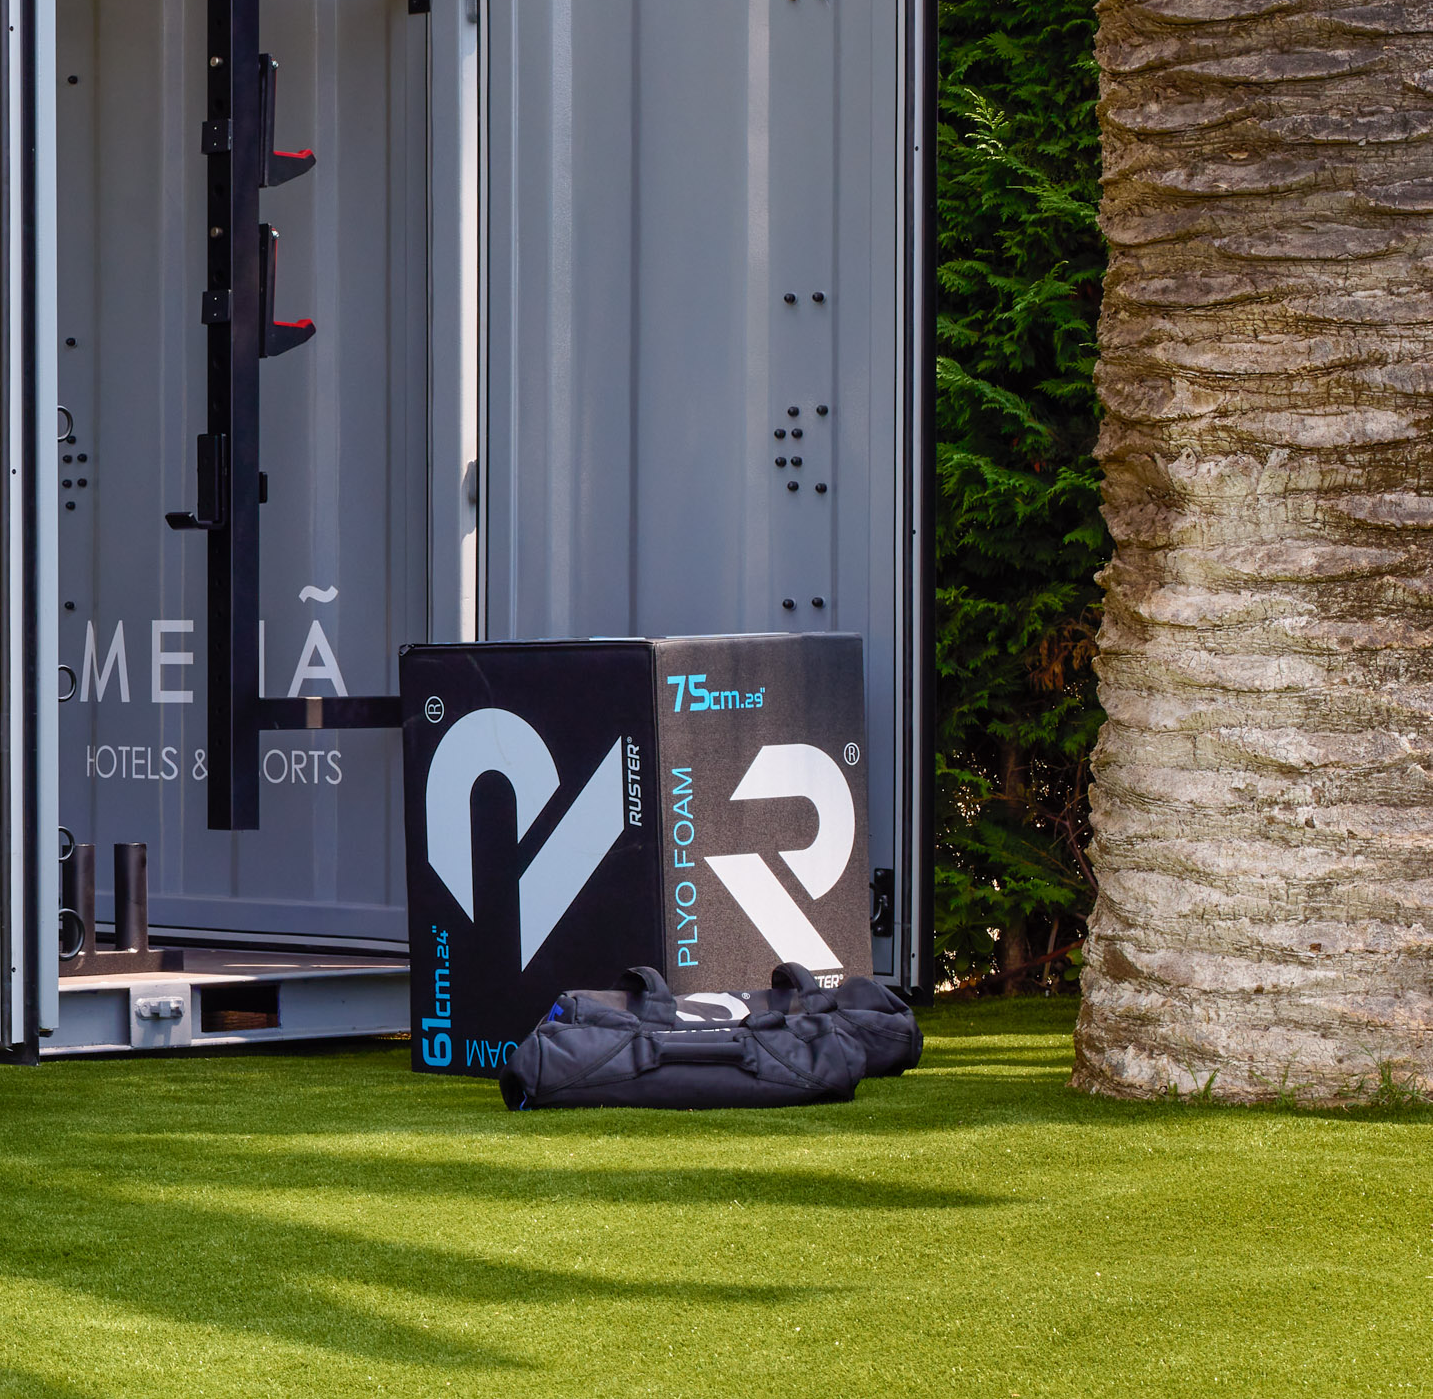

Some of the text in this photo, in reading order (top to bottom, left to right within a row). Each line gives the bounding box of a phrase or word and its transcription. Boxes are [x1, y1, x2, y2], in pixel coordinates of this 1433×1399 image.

[86, 744, 179, 781] HOTELS
[191, 748, 208, 781] &
[671, 767, 699, 968] PLYO FOAM
